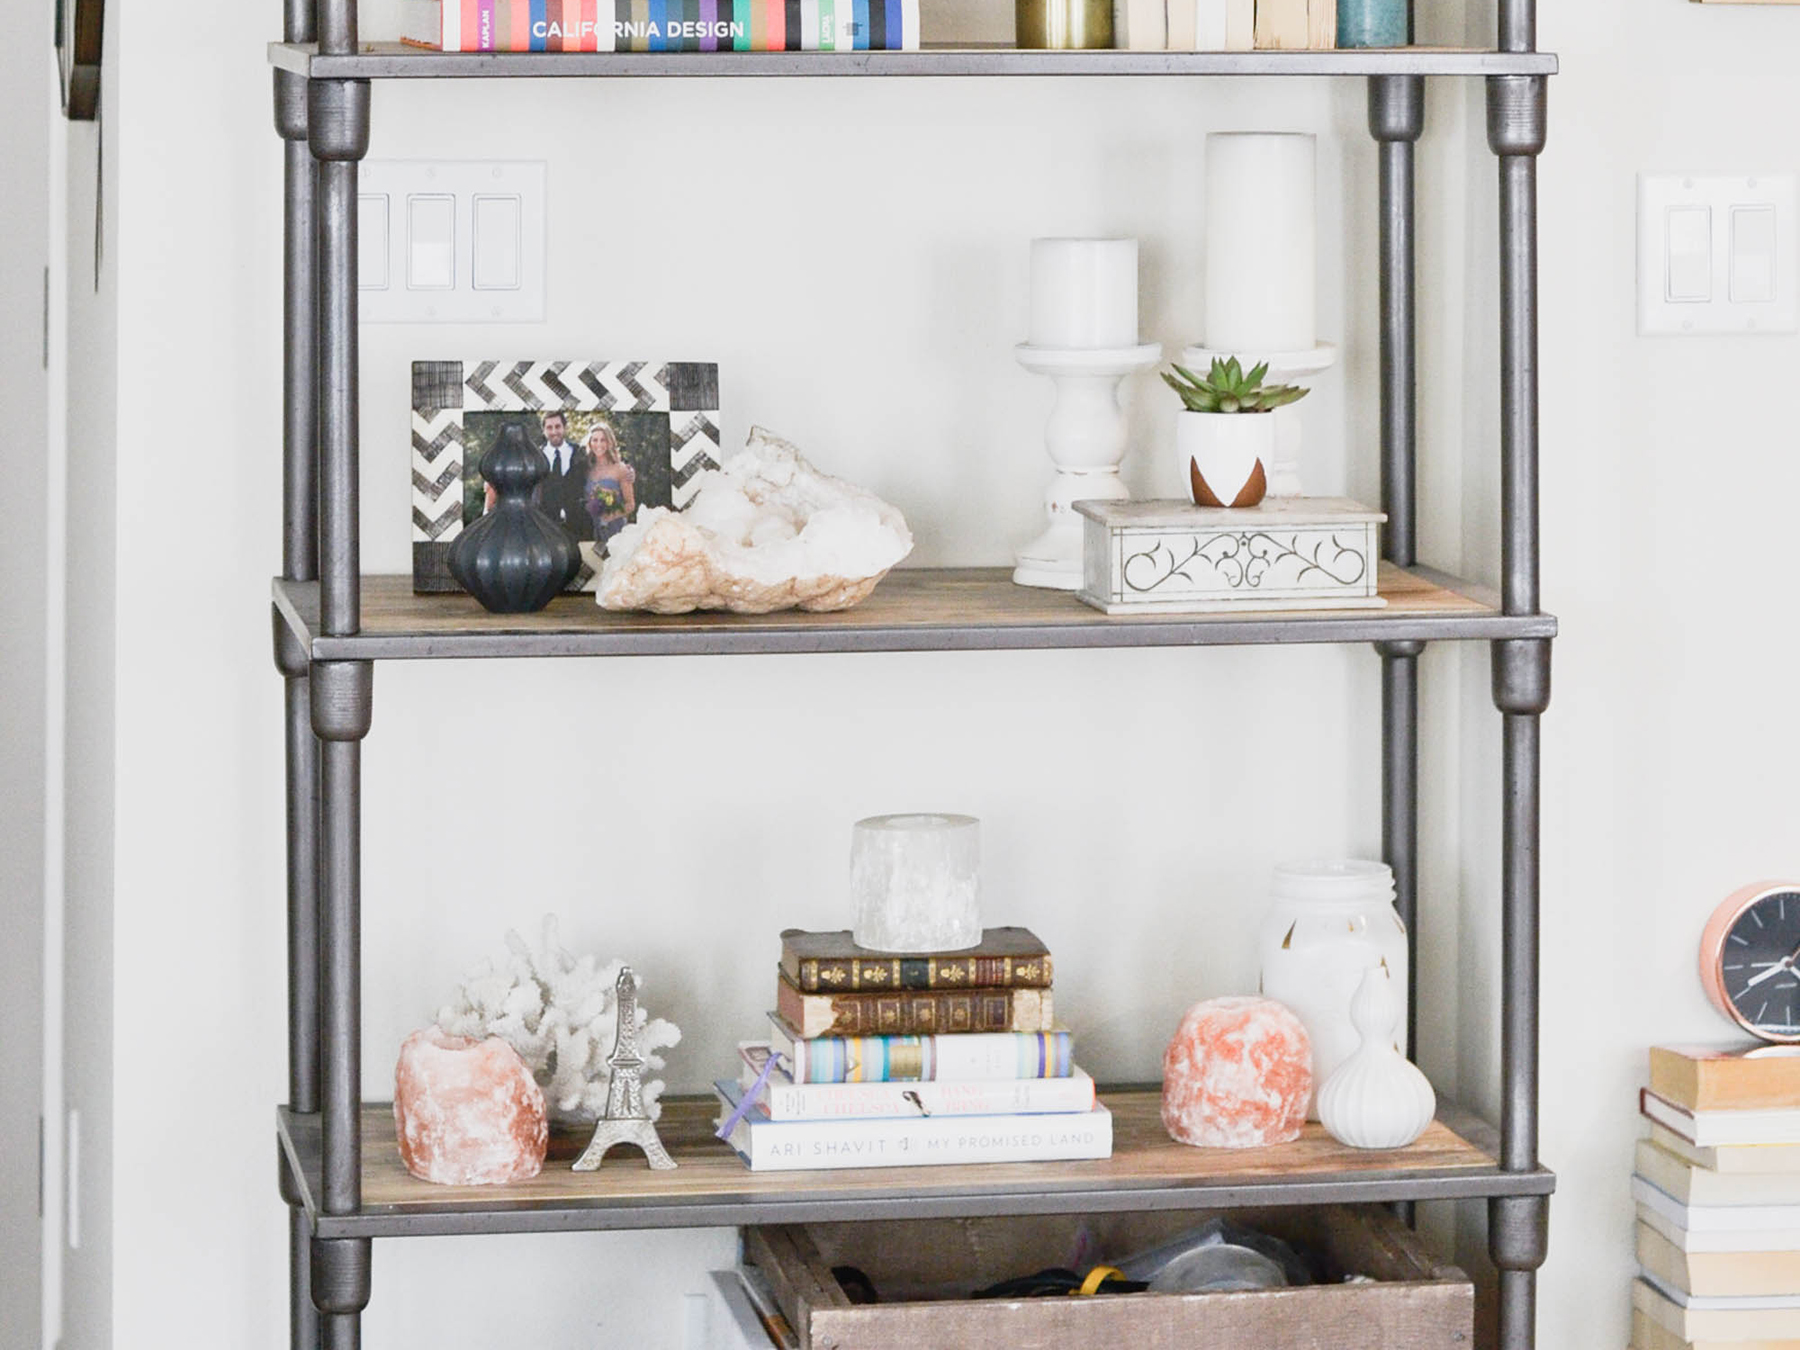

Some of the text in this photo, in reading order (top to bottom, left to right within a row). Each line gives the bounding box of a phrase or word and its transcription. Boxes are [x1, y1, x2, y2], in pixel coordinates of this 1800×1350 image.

[481, 10, 490, 48] KAPLAN
[667, 21, 744, 39] DESIGN
[771, 1132, 1095, 1157] ARI SHAVIT MY PROMISED LAND
